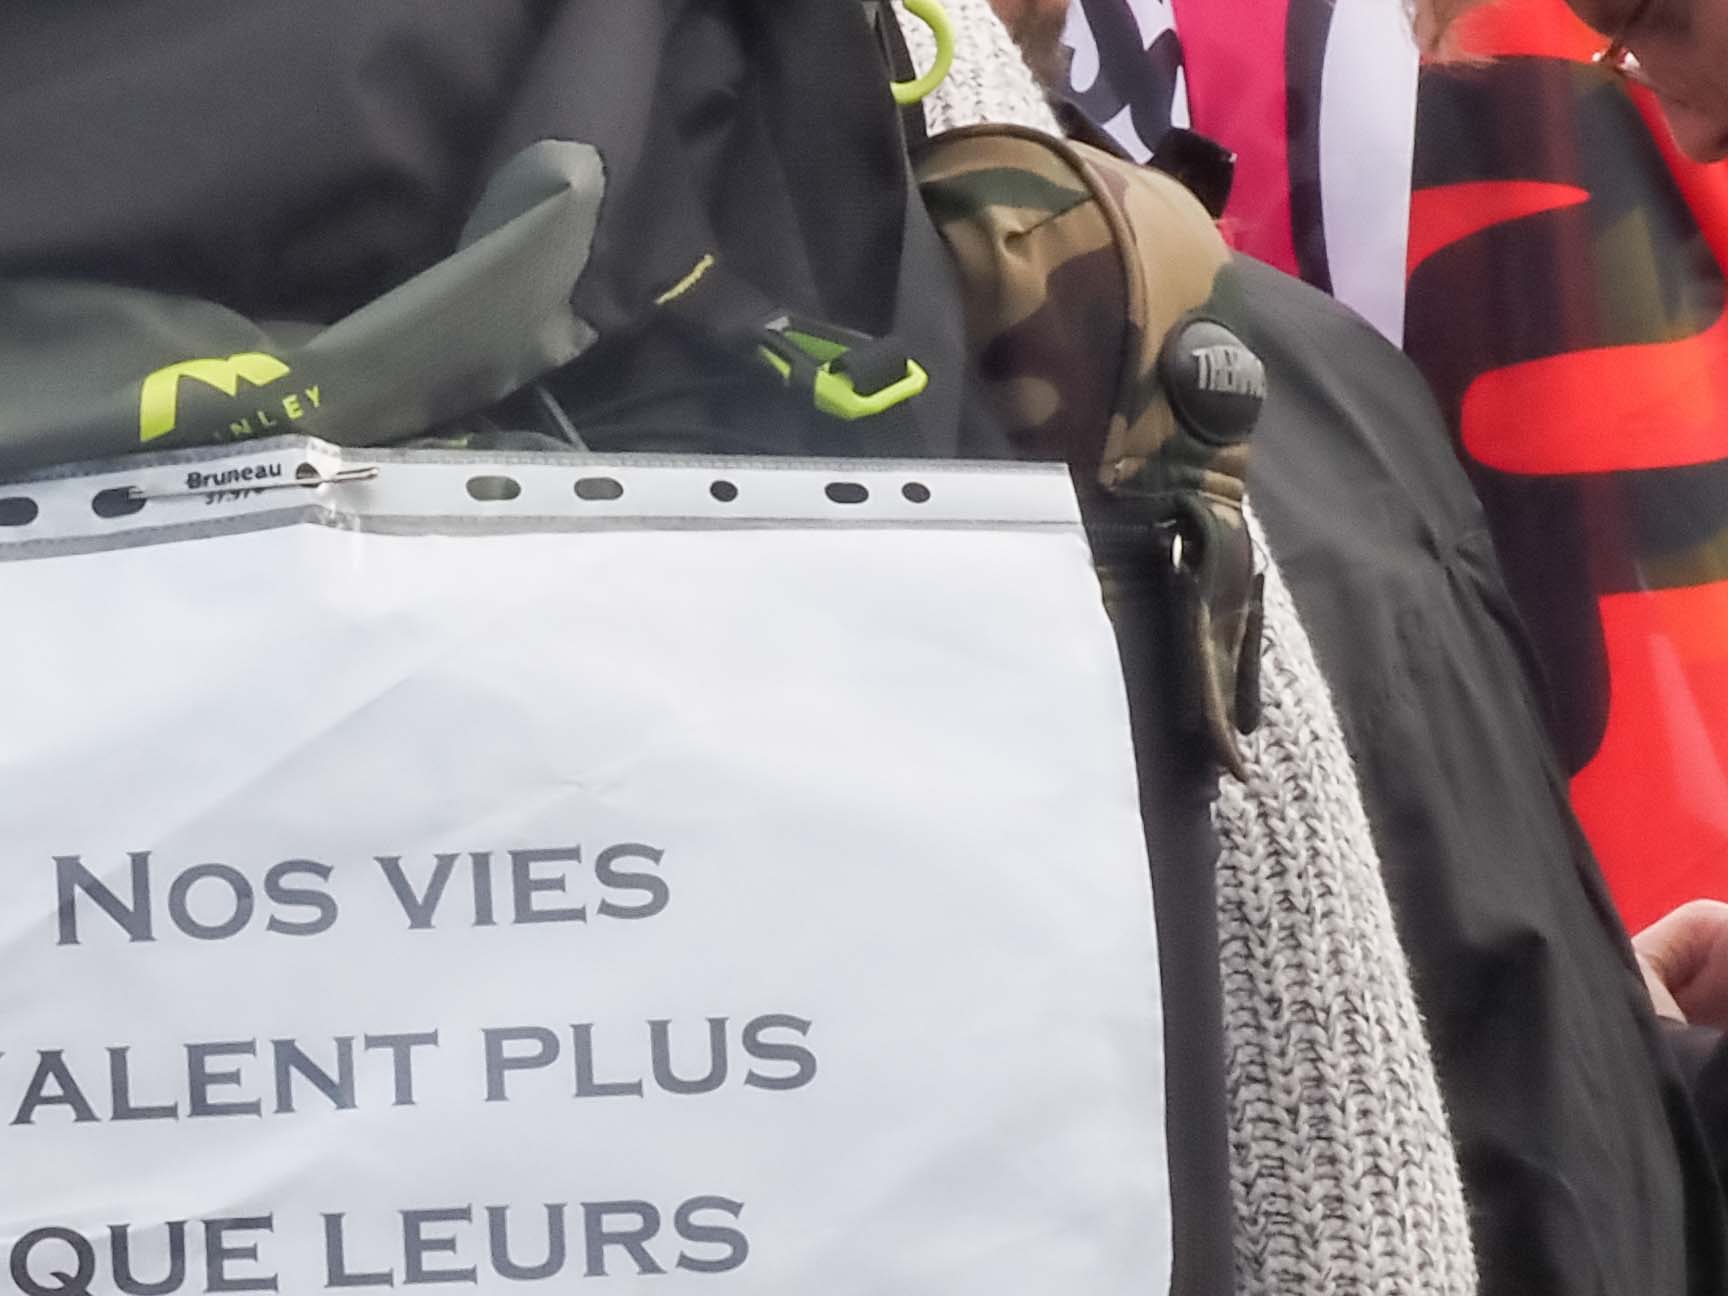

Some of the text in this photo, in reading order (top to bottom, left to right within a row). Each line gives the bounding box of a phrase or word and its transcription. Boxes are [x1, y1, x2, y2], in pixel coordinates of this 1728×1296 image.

[185, 461, 282, 489] Bruneau
[372, 842, 672, 931] VIES
[480, 1012, 820, 1103] PLUS
[320, 1195, 751, 1290] LEURS
